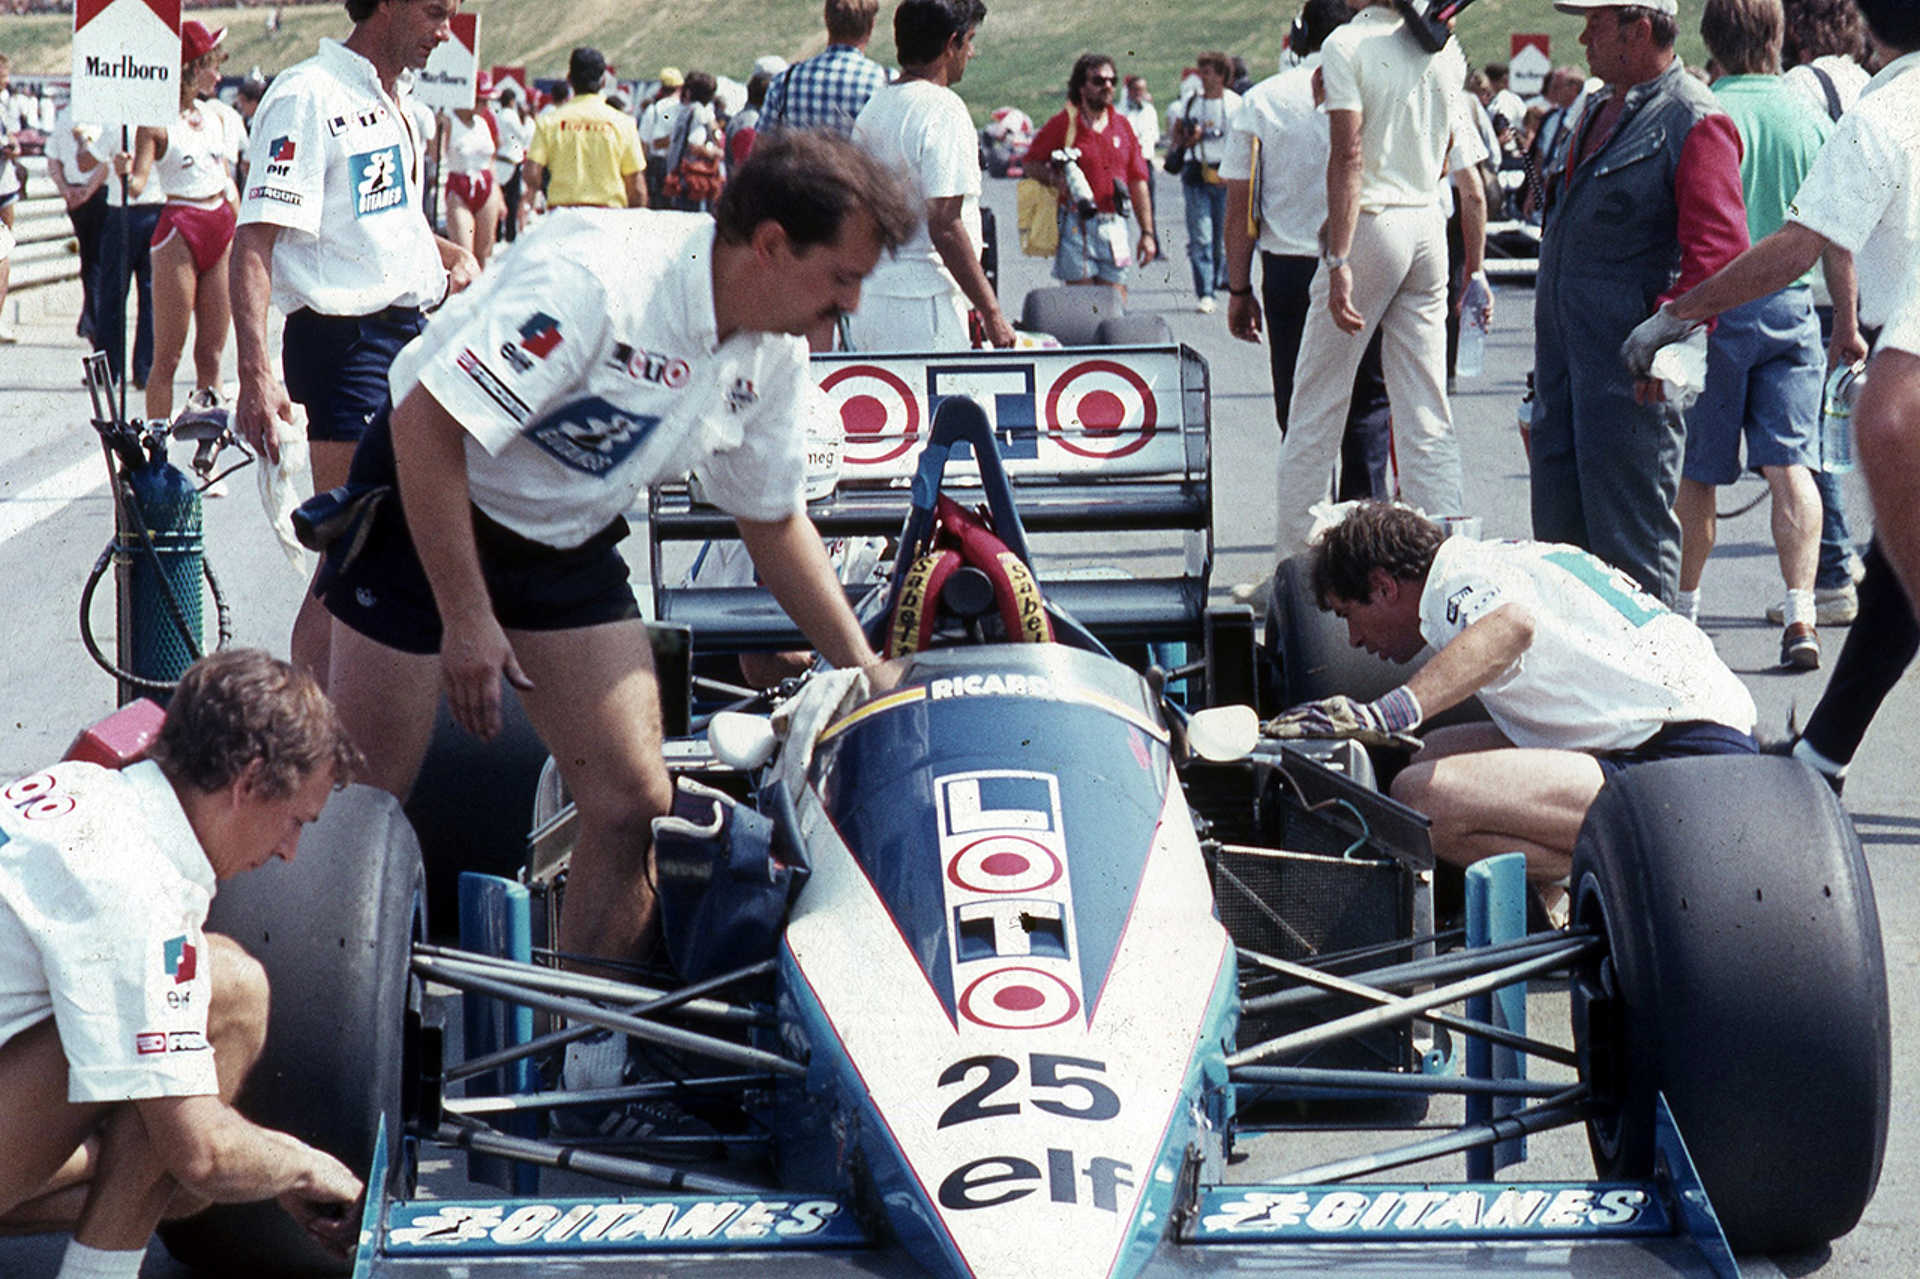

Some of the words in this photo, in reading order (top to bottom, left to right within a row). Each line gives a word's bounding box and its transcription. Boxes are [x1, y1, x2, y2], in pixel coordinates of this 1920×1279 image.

[85, 54, 169, 81] Marlboro
[939, 773, 1081, 1031] LOTO
[936, 1052, 1122, 1131] 25
[937, 1147, 1135, 1214] elf
[490, 1201, 844, 1246] GITANES
[1305, 1187, 1650, 1233] GITANES
